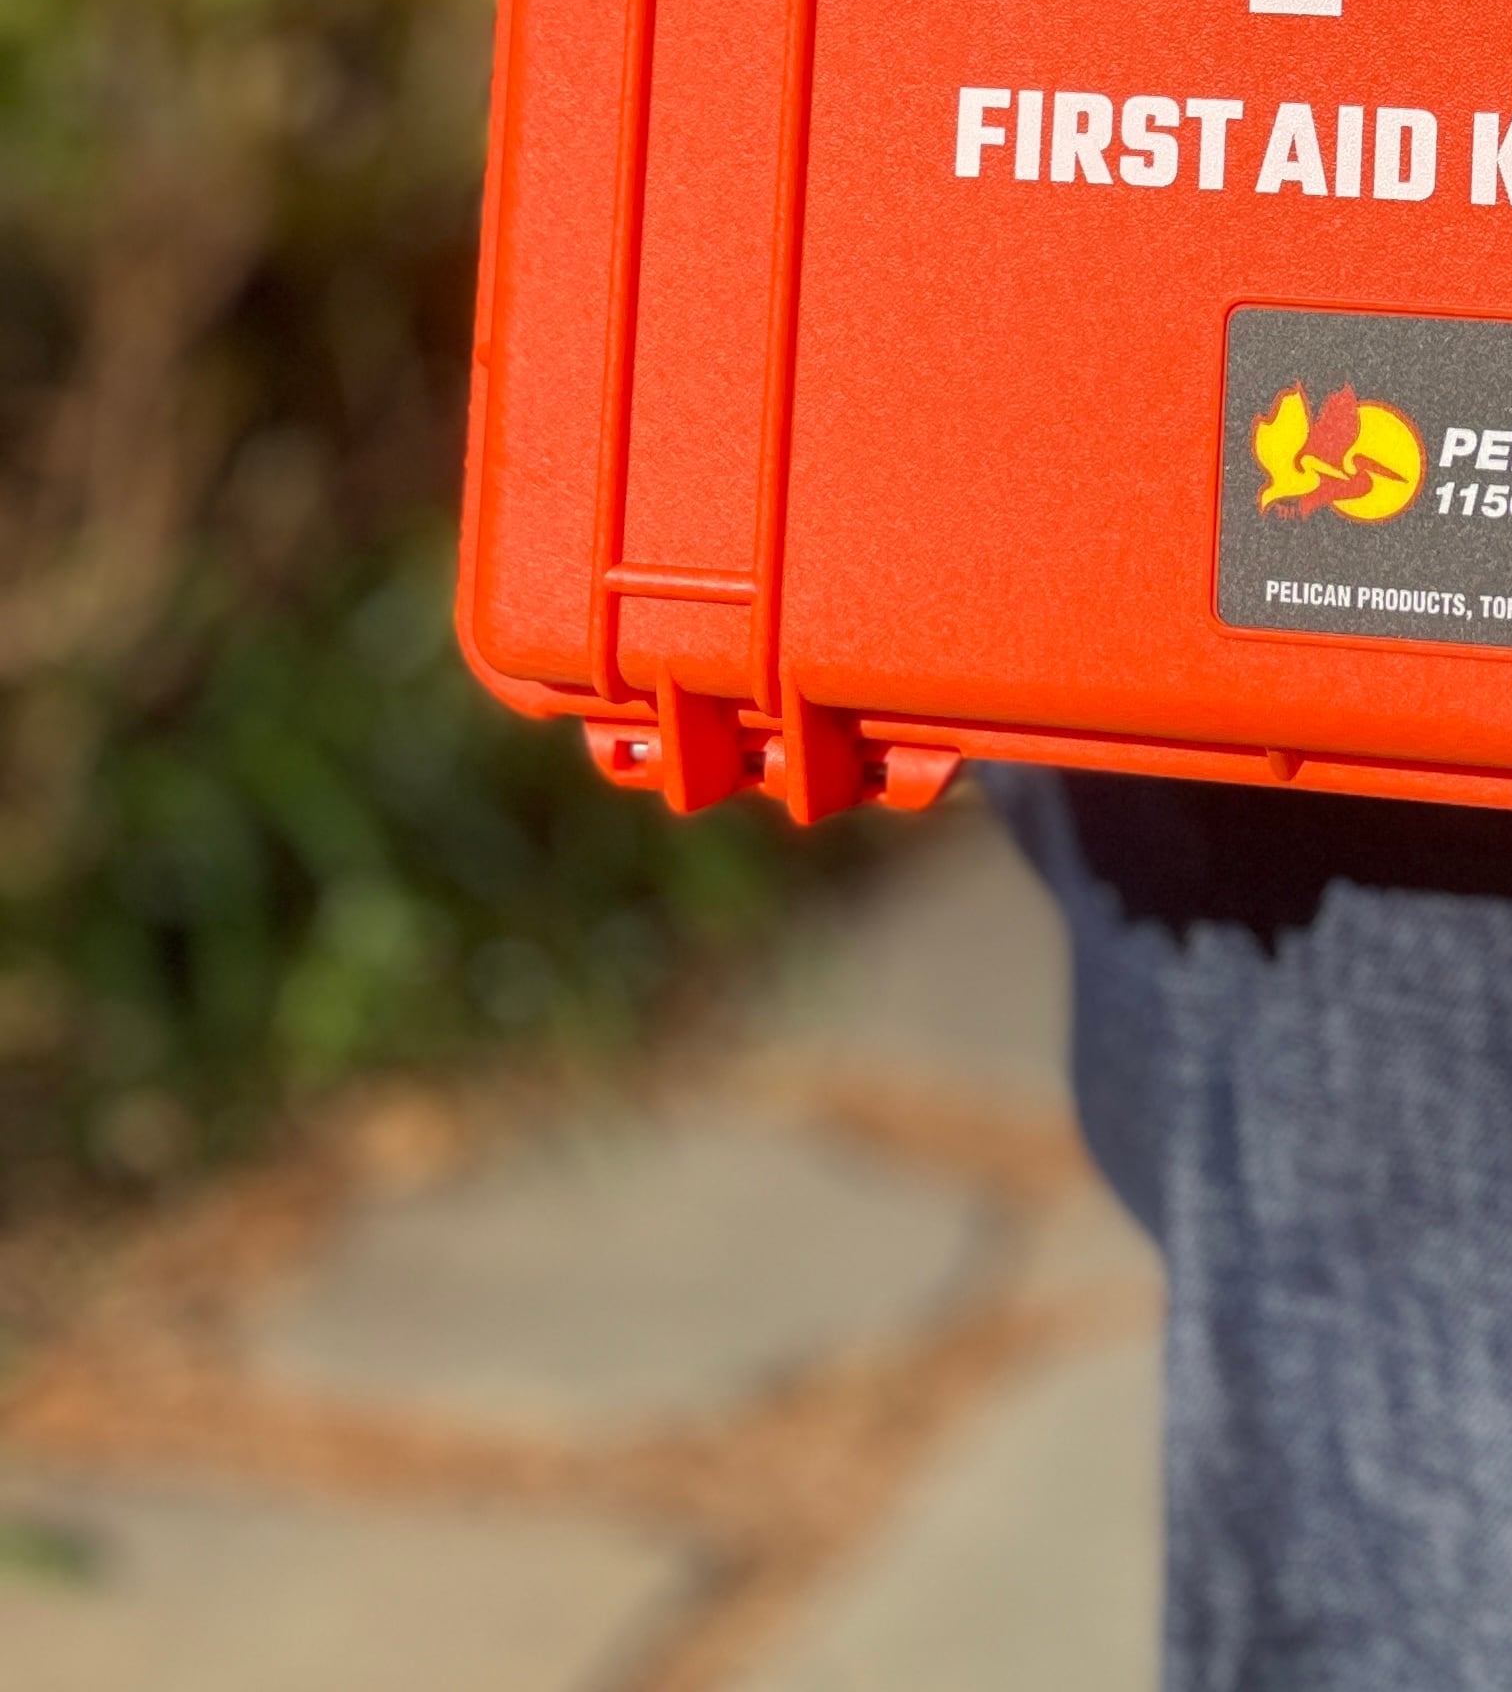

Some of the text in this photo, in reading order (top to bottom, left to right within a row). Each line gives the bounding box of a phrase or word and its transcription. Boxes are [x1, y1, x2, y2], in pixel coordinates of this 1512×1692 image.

[954, 86, 1244, 191] FIRST
[1255, 101, 1438, 202] AID
[1265, 579, 1351, 608] PELICAN
[1357, 586, 1473, 621] PRODUCTS,
